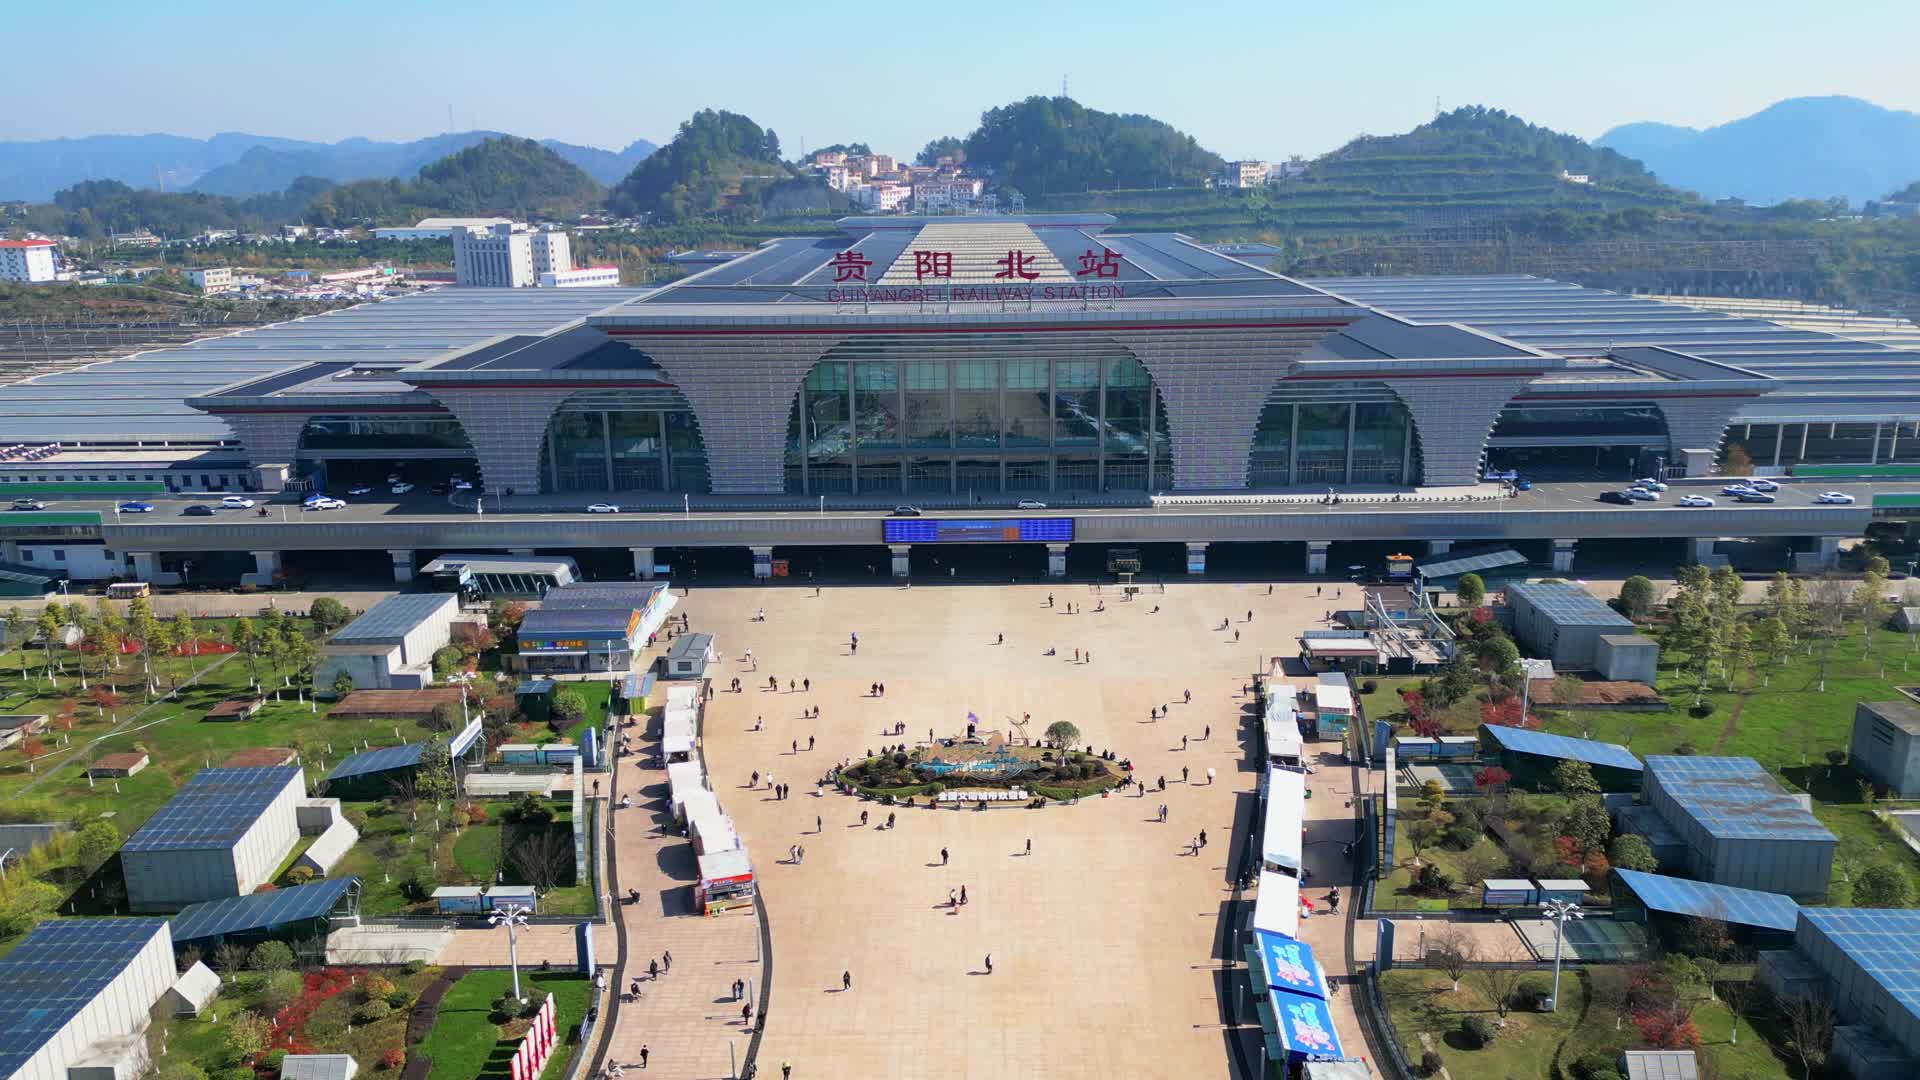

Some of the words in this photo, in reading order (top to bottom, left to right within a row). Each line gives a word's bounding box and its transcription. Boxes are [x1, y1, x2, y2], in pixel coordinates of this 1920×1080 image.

[829, 249, 1122, 282] 贵阳北站
[828, 288, 943, 302] GUIYANGBEI
[953, 287, 1033, 301] RAILWAY
[1044, 286, 1125, 300] STATION
